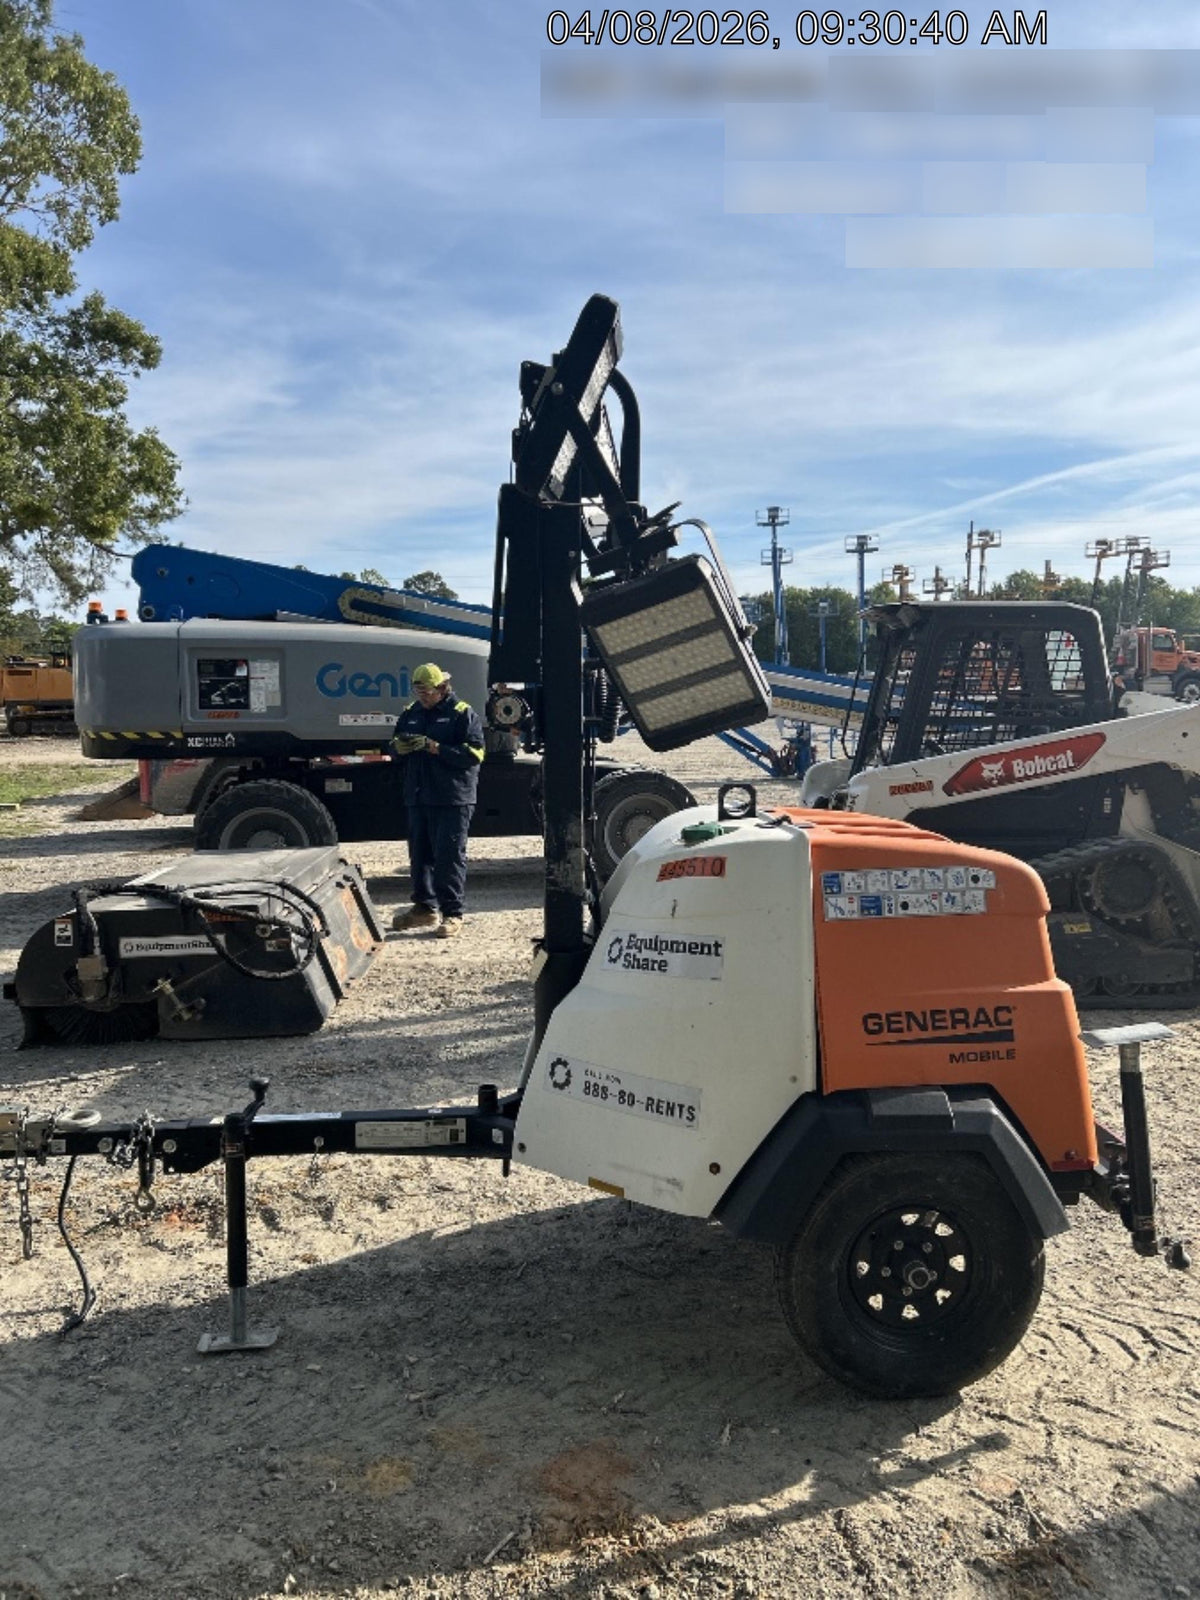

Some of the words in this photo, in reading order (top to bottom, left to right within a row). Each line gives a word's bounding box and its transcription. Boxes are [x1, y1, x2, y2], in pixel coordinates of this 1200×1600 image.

[316, 662, 410, 698] Geni
[1012, 750, 1075, 778] Bobcat
[625, 933, 722, 957] Equipment
[622, 952, 668, 973] Share
[862, 1005, 1013, 1036] GENERAC
[949, 1049, 1016, 1065] MOBILE
[583, 1080, 696, 1122] 888-80-RENTS
